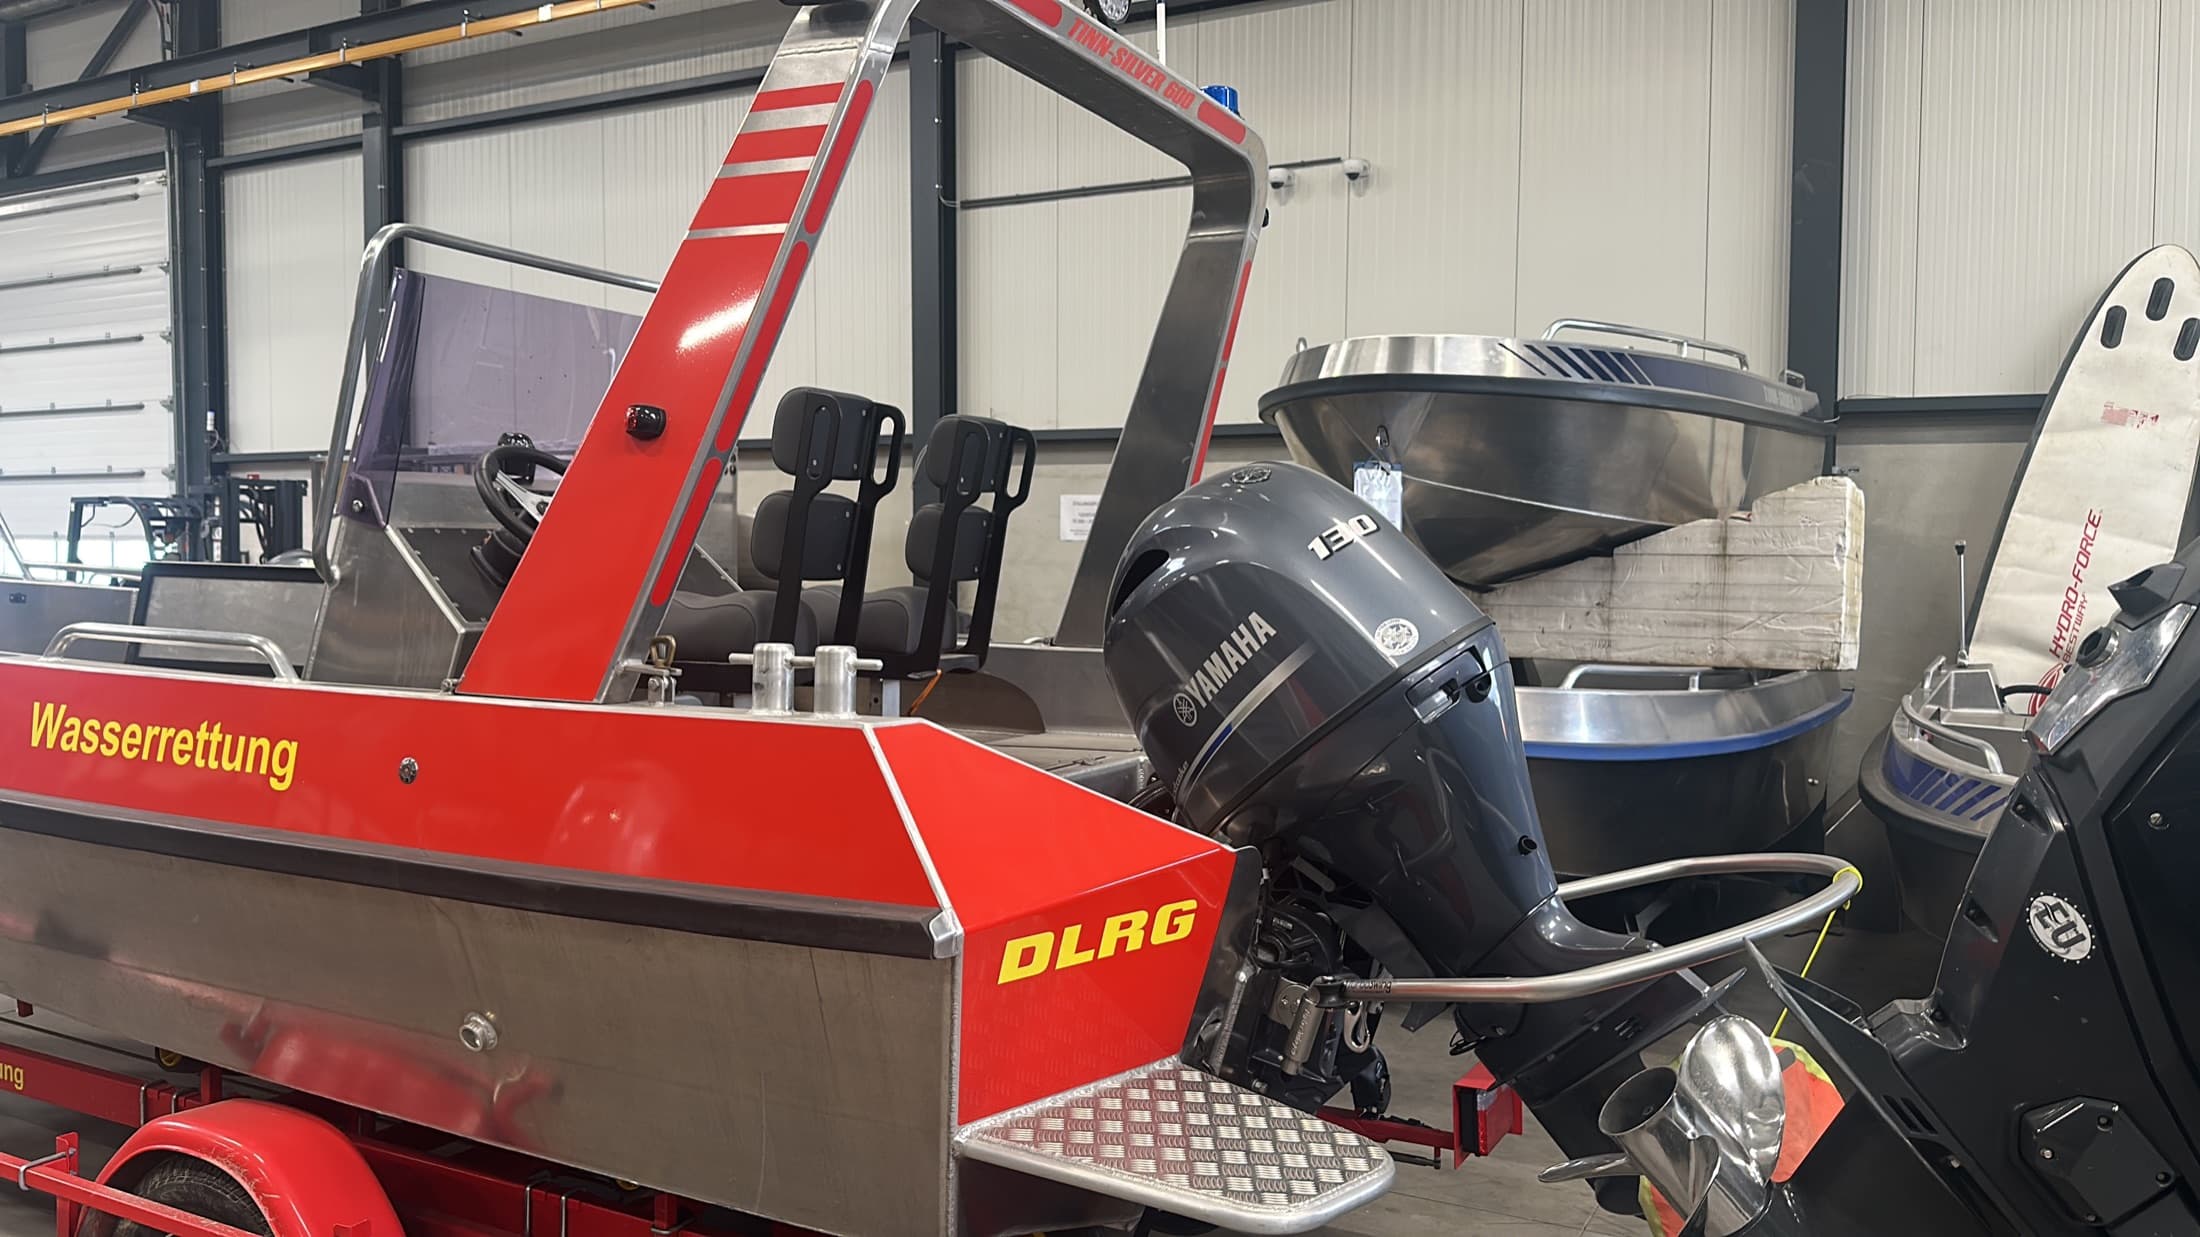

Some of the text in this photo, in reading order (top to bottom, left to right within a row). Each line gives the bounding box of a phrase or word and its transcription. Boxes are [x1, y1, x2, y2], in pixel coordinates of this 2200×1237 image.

[1068, 17, 1196, 110] TINN-SILVER 600
[1307, 514, 1379, 560] 130
[2050, 509, 2102, 658] HYDRO-FORCE
[1185, 611, 1277, 708] YAMAHA
[2063, 597, 2088, 664] BESTWAY
[31, 702, 298, 791] Wasserrettung
[997, 899, 1198, 985] DLRG
